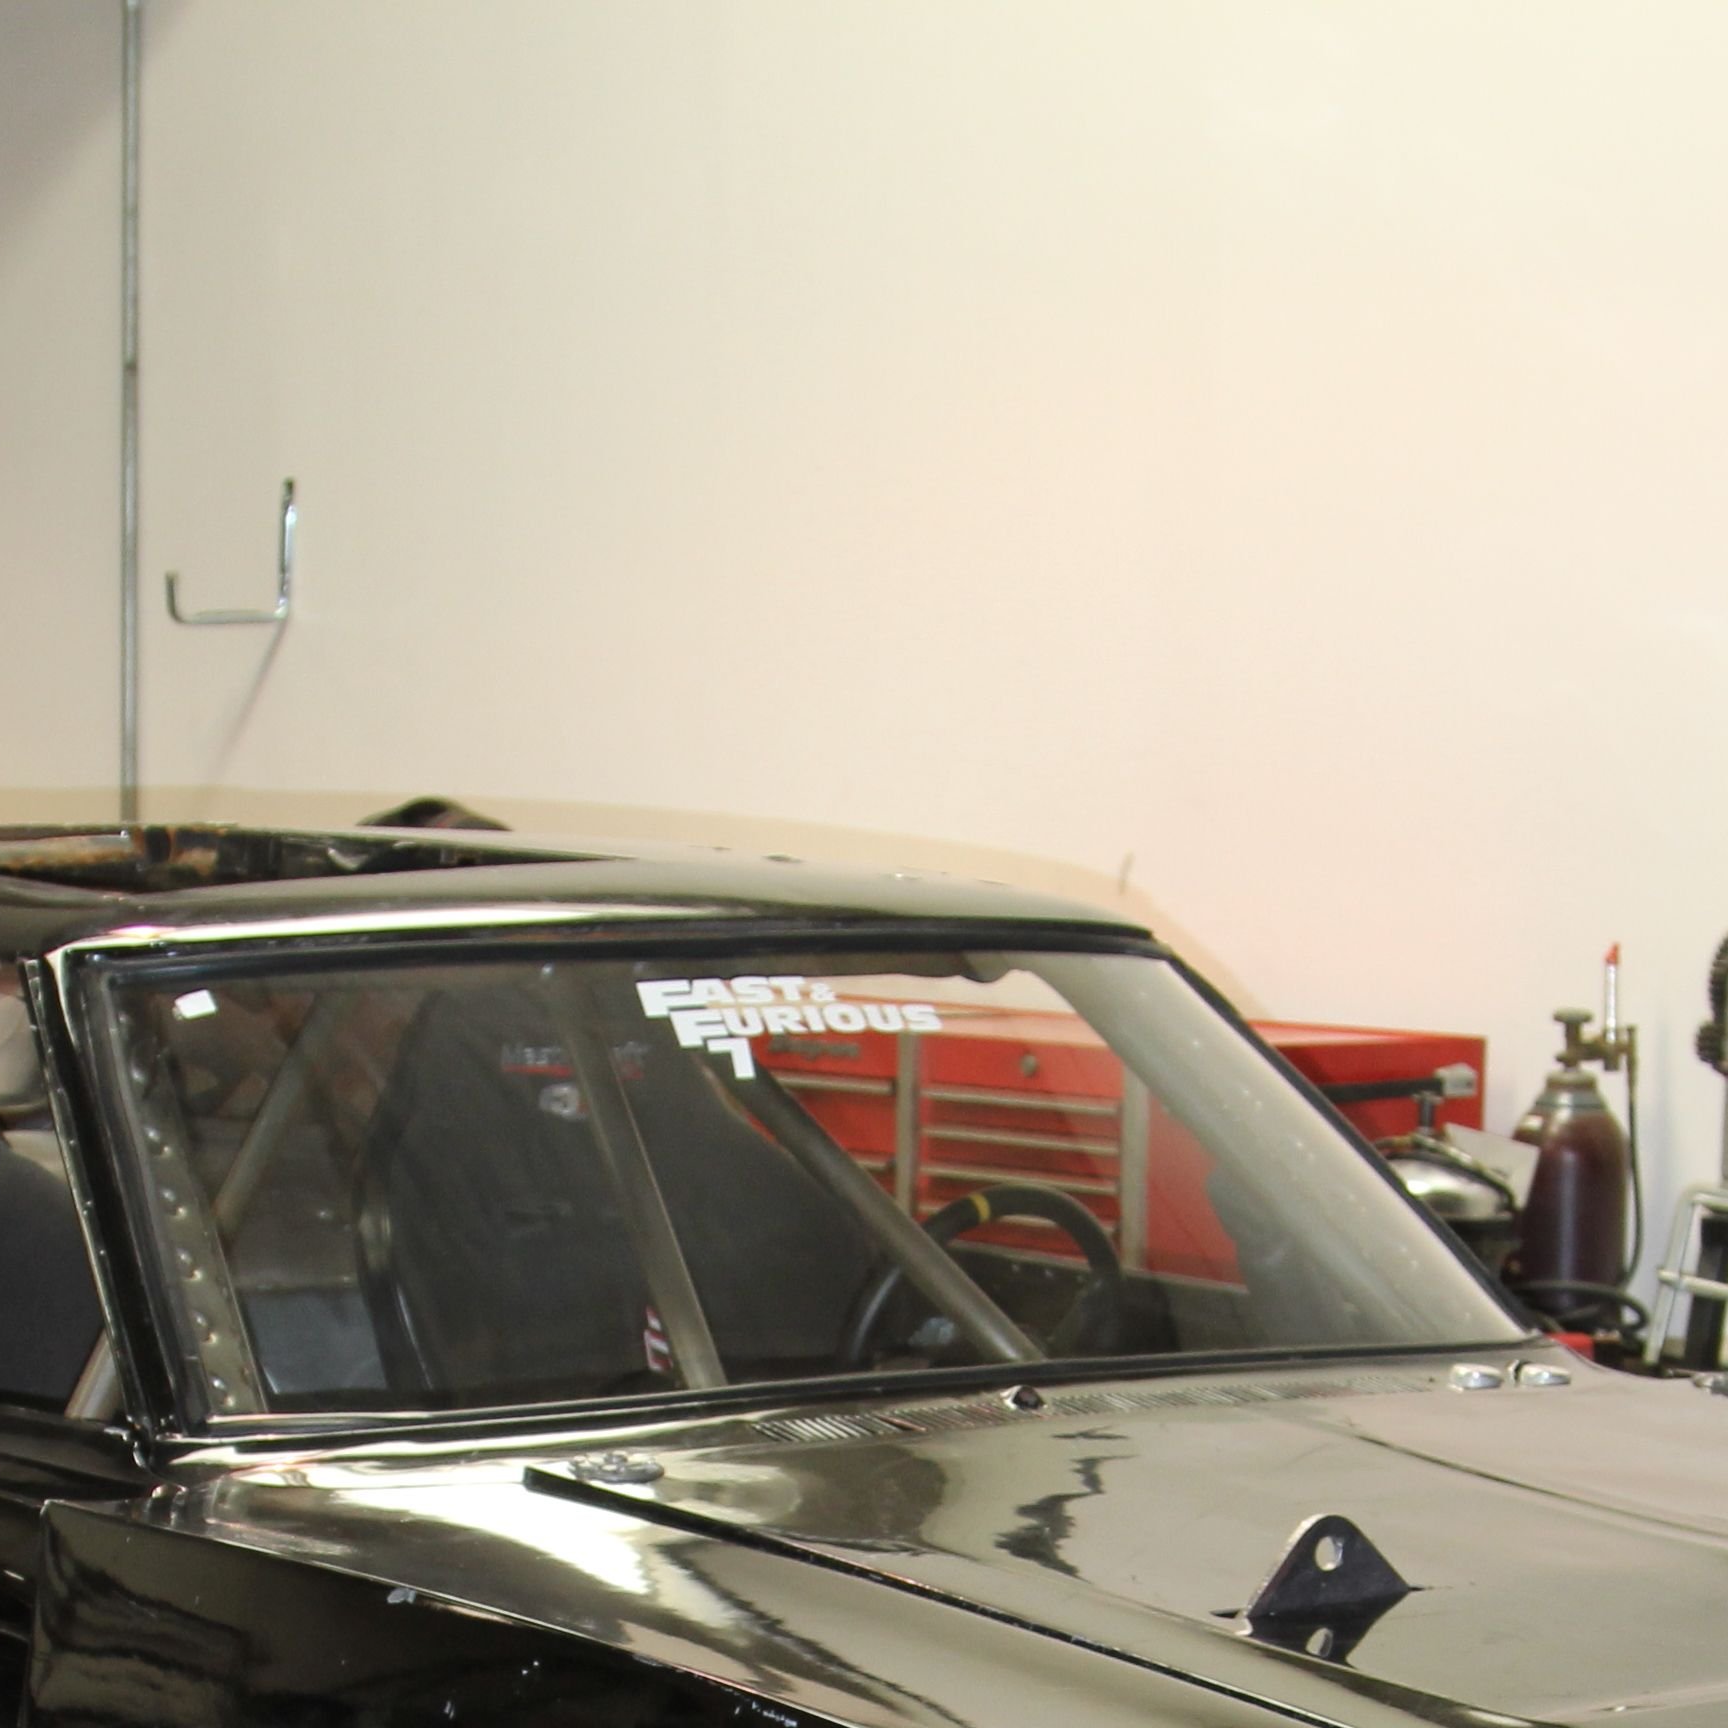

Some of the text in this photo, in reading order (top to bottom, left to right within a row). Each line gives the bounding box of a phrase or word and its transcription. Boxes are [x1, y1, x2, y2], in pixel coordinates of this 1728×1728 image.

[635, 976, 837, 1018] FAST &
[670, 1003, 942, 1048] FURIOUS
[707, 1036, 756, 1079] 7
